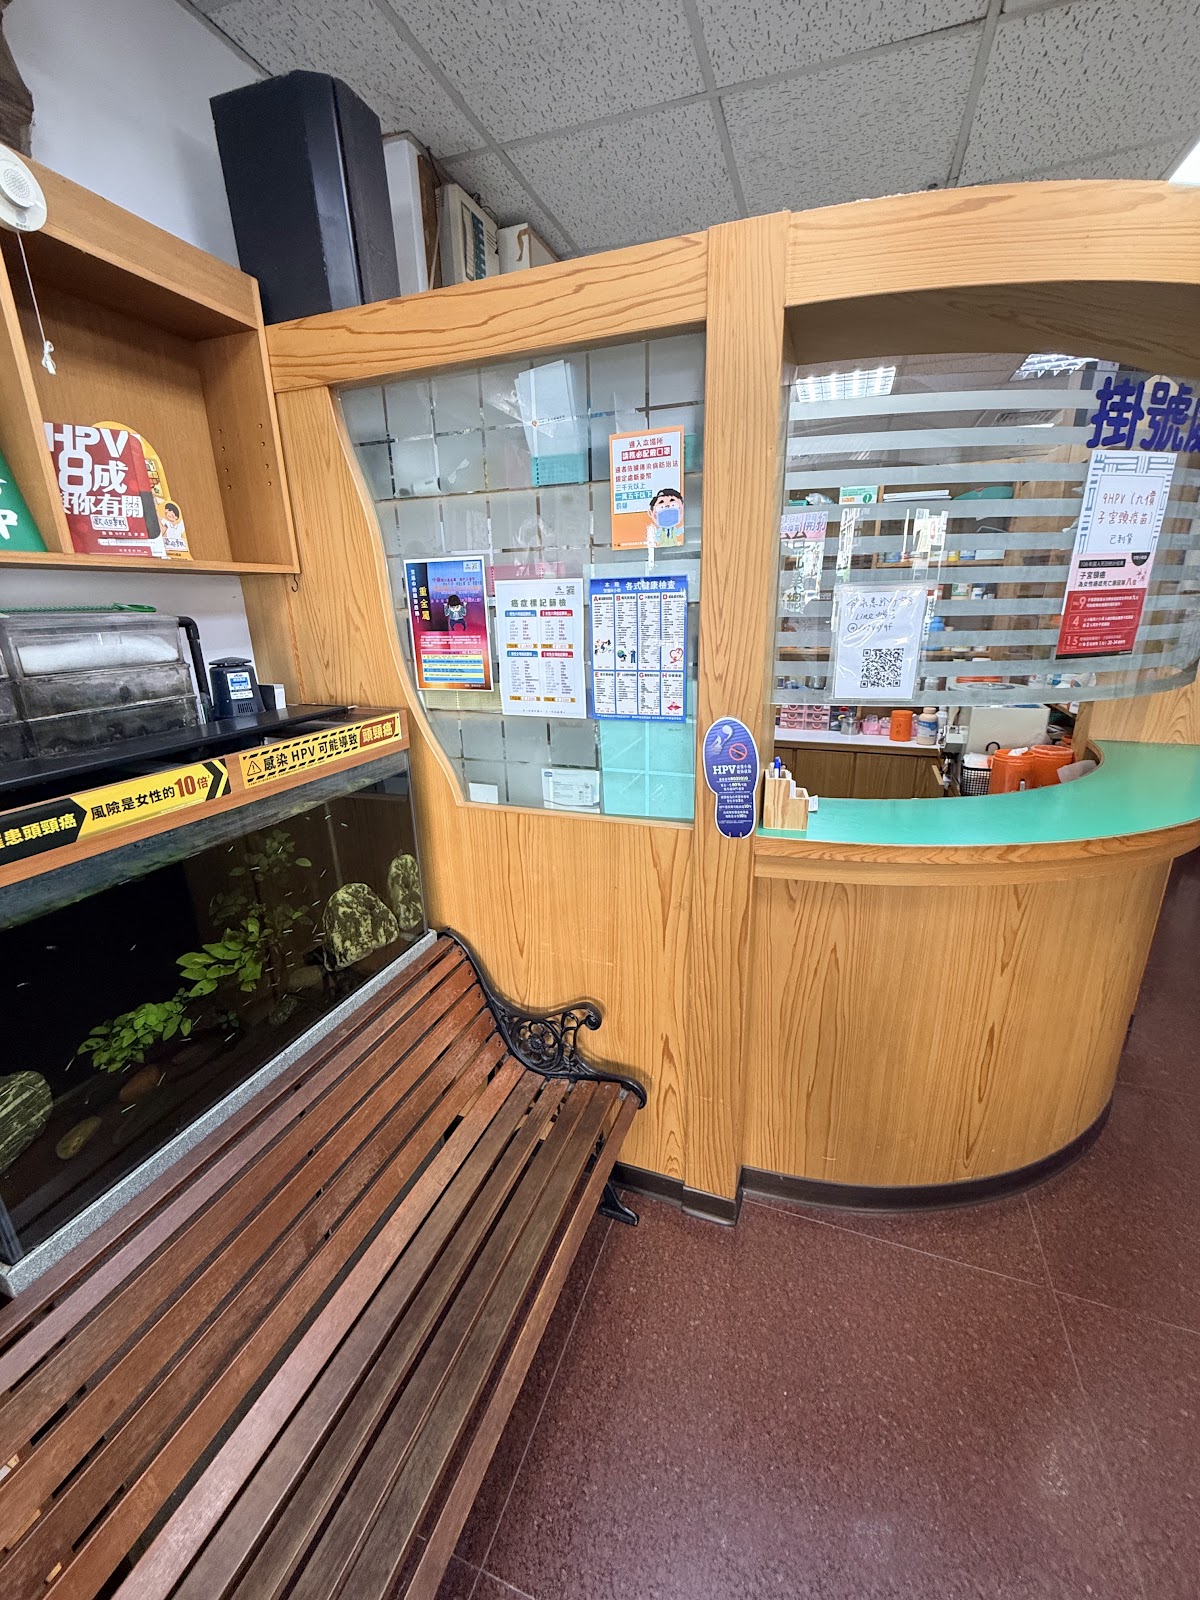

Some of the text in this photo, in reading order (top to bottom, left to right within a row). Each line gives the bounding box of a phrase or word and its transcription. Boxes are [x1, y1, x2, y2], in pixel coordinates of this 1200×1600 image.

[43, 421, 129, 458] HPV
[58, 448, 128, 495] 8成
[362, 723, 394, 743] 頭頸癌
[264, 732, 358, 772] 感染 HPV 可能導致
[712, 764, 736, 775] HPV
